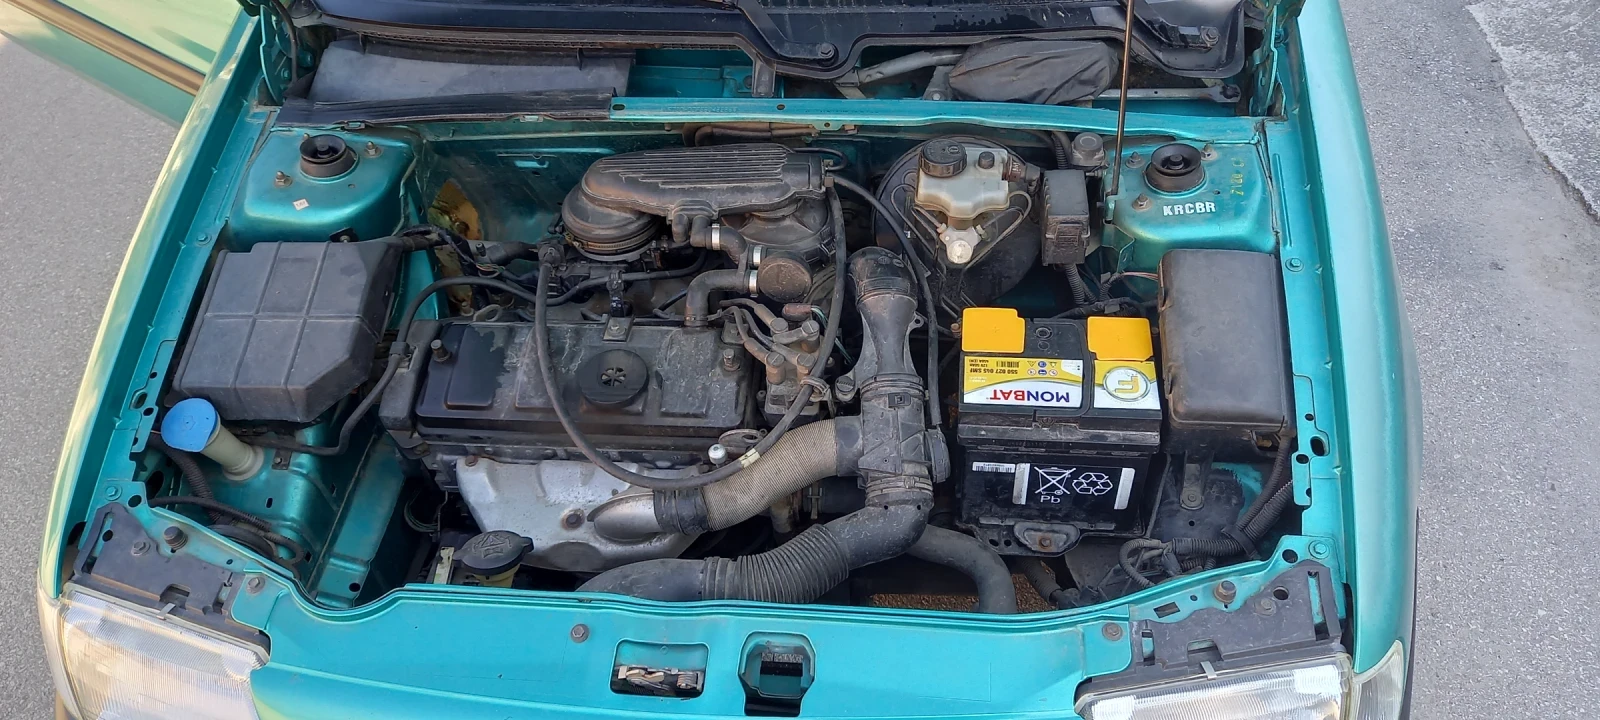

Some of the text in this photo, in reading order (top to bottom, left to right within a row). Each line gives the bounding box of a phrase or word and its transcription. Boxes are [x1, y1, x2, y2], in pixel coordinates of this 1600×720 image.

[1162, 201, 1216, 216] KRCBR
[990, 389, 1070, 403] MONBAT
[1040, 495, 1061, 504] Pb
